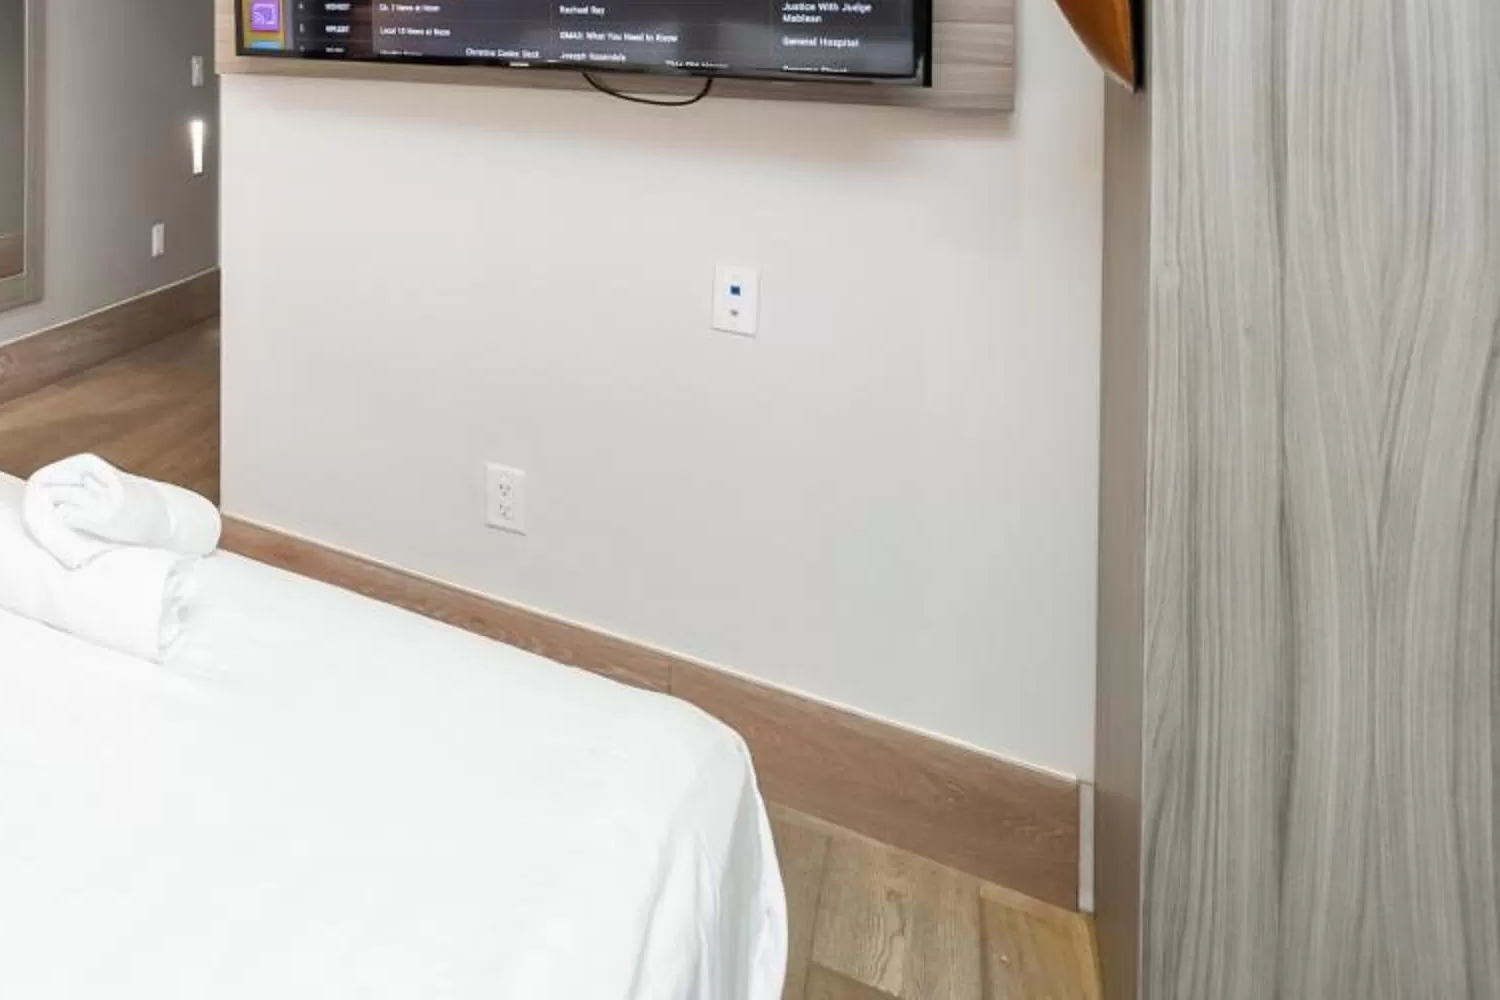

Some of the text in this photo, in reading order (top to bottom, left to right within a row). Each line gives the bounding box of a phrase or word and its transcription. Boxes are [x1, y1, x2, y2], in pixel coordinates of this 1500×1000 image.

[781, 2, 873, 14] Justice With Judge
[782, 14, 822, 23] Mablean
[781, 36, 860, 48] General Hospital
